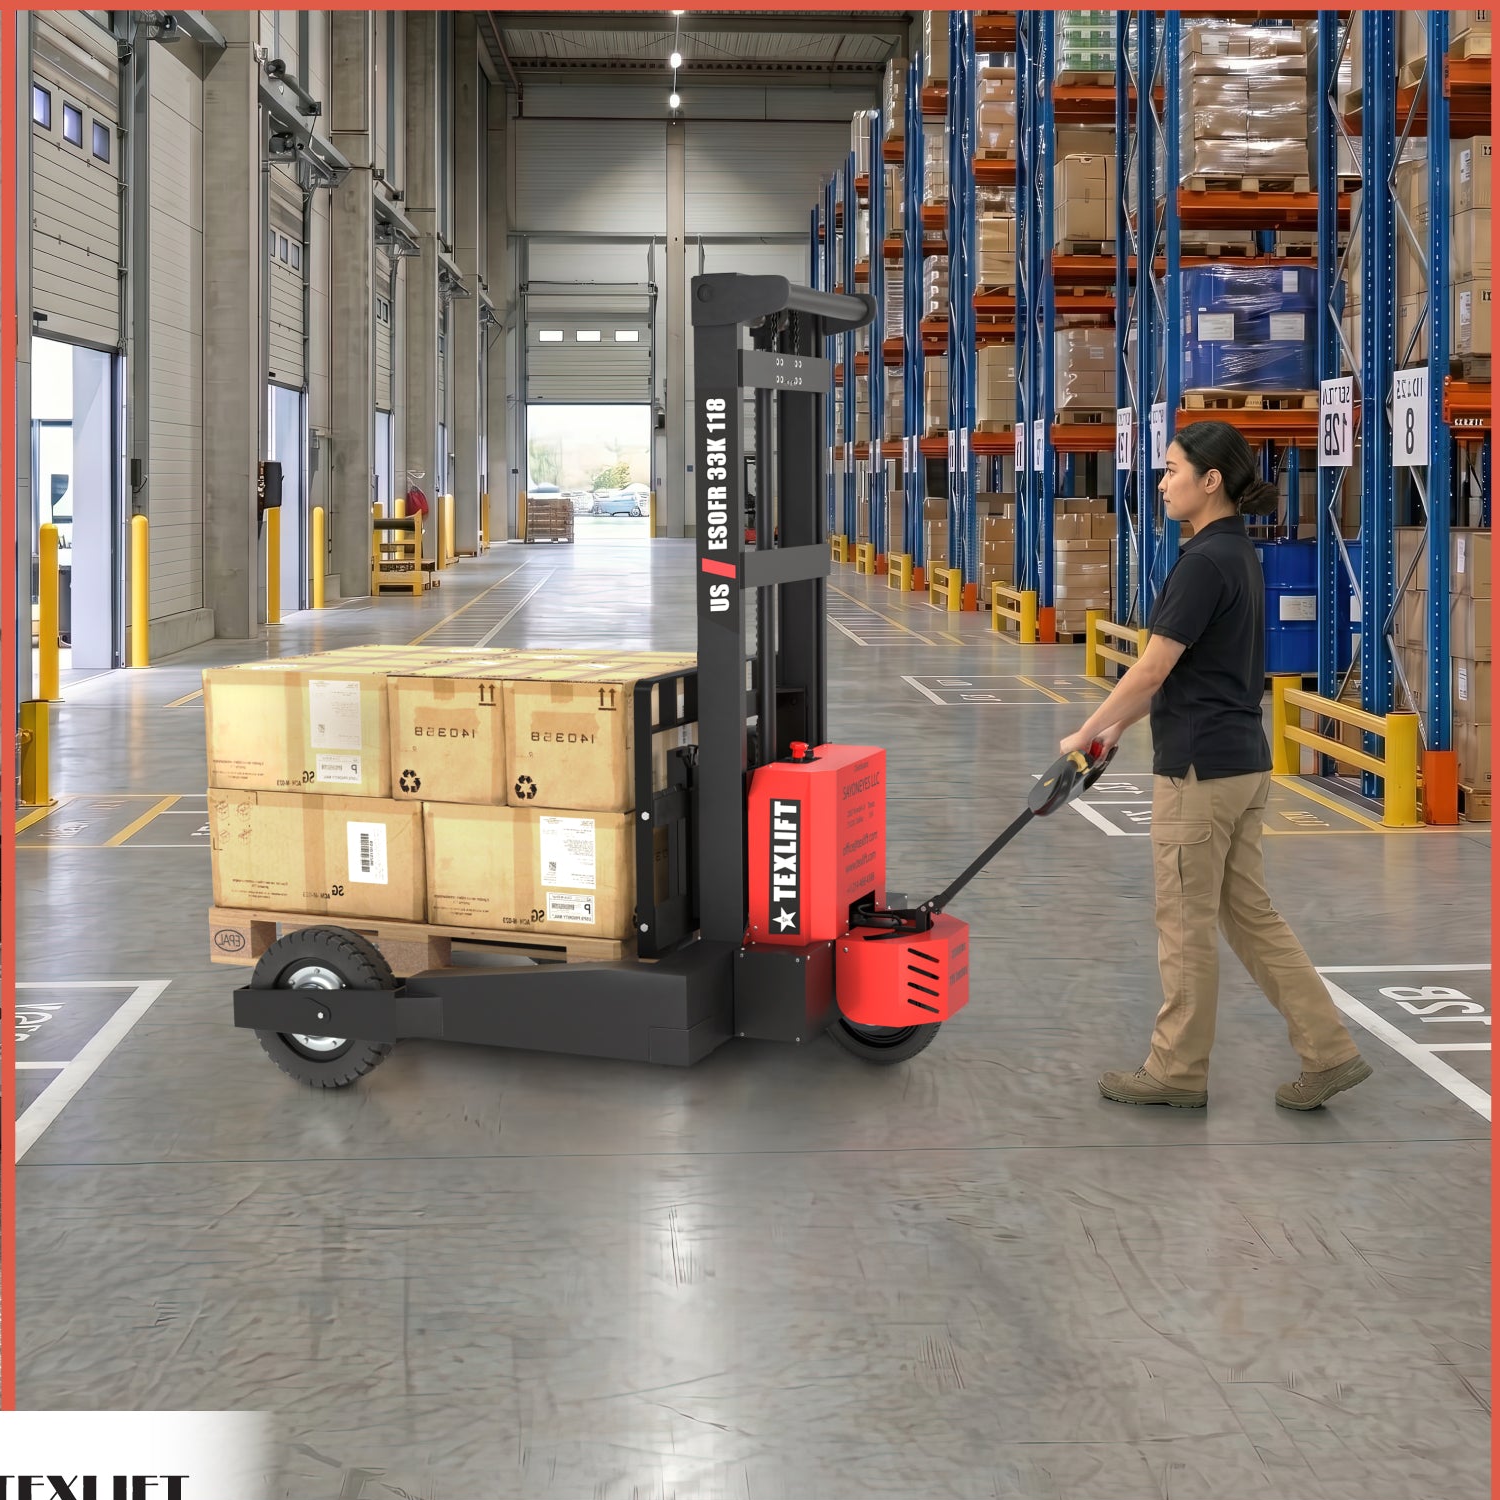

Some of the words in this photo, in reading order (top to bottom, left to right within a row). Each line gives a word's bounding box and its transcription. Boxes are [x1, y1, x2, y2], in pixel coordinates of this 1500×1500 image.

[706, 397, 726, 432] 118
[707, 437, 727, 481] 33K
[708, 484, 728, 550] ESOFR
[709, 584, 730, 612] US
[774, 801, 797, 902] TEXLIFT
